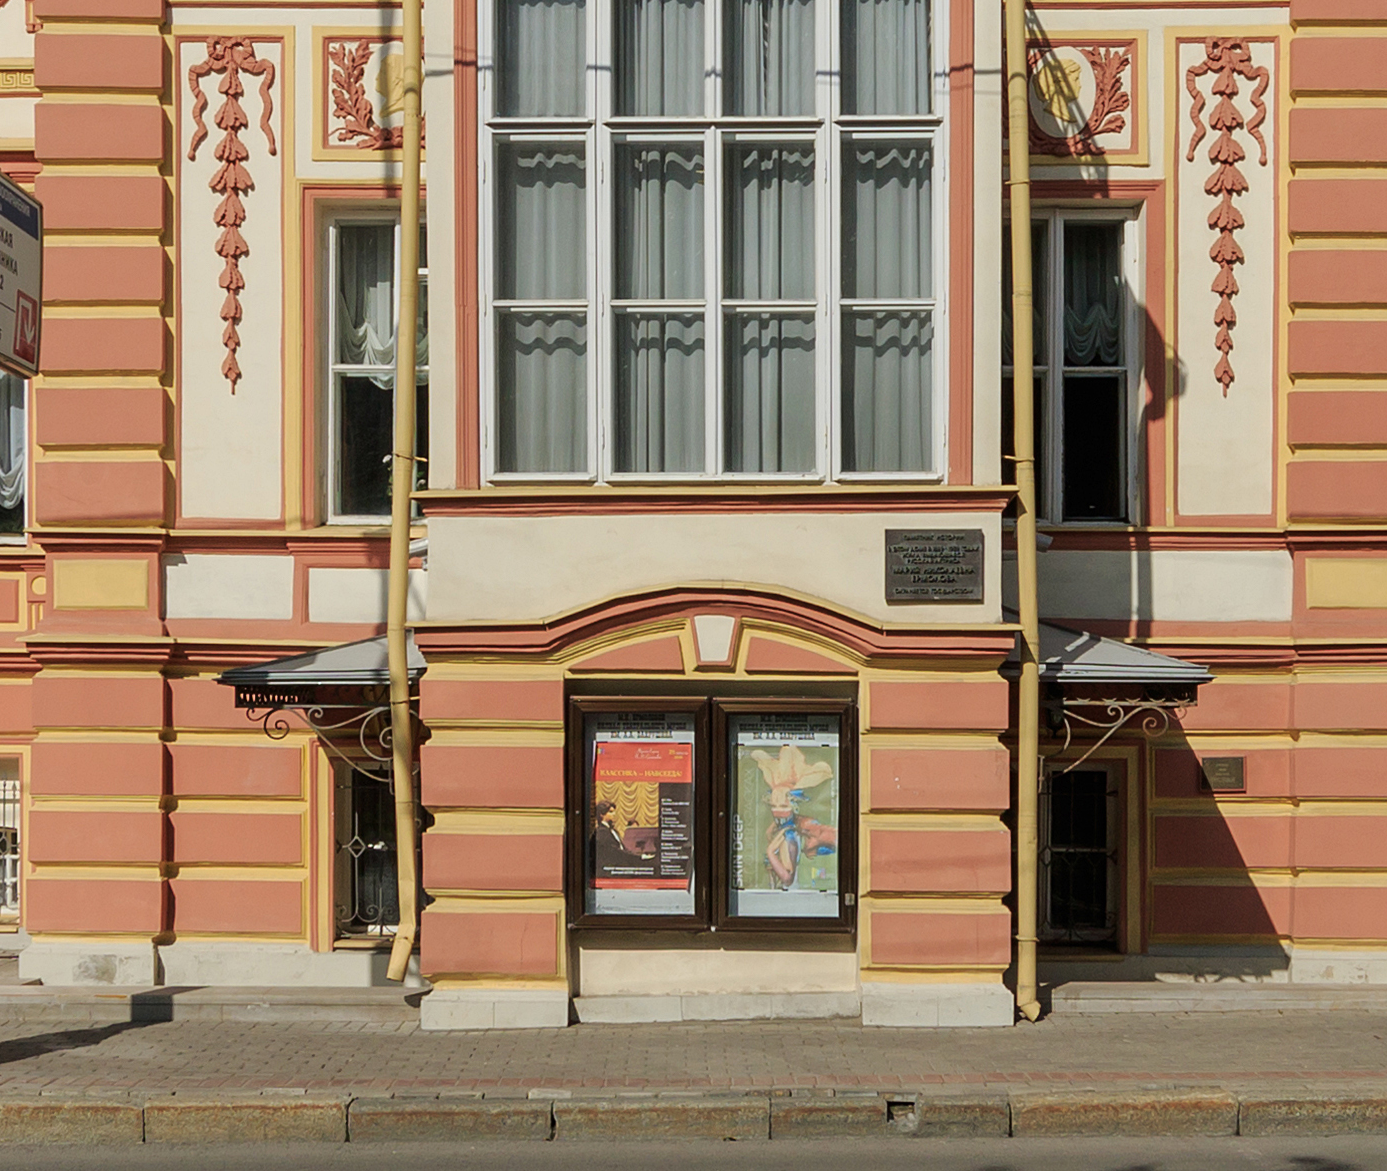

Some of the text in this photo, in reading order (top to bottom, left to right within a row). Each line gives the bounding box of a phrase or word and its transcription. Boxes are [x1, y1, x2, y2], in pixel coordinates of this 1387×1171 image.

[599, 769, 638, 777] КЛАССИКА
[732, 814, 744, 887] SKIN DEEP
